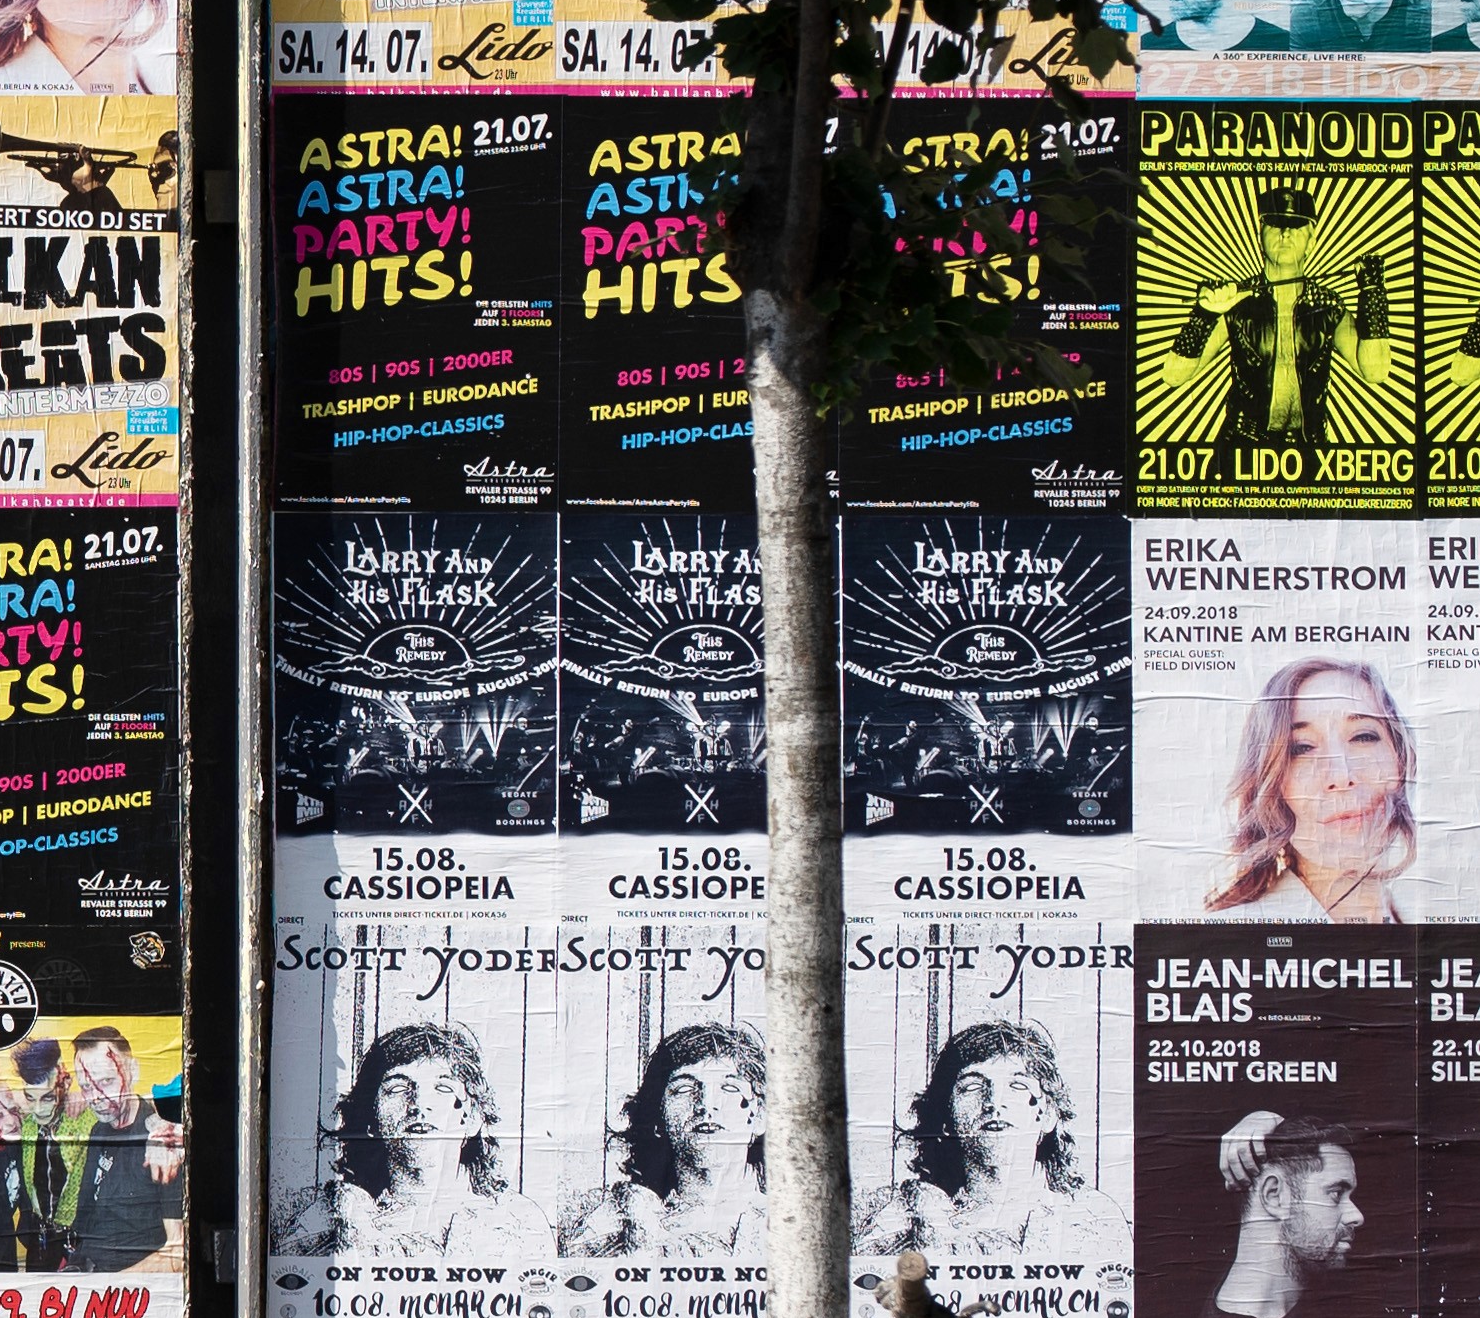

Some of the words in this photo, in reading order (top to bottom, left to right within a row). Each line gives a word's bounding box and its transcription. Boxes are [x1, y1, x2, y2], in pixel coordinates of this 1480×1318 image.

[1140, 111, 1413, 157] PARANOID
[1138, 449, 1223, 481] 21.07.
[1234, 449, 1303, 481] LIDO
[1316, 449, 1413, 481] XBERG
[84, 526, 163, 559] 21.07.
[1145, 539, 1242, 562] ERIKA
[1146, 566, 1406, 590] WENNERSTROM
[1145, 606, 1238, 619] 24.09.2018
[1144, 626, 1243, 643] KANTINE
[1251, 626, 1286, 643] AM
[1295, 626, 1409, 643] BERGHAIN
[1144, 650, 1185, 658] SPECIAL
[1189, 650, 1224, 658] GUEST:
[1145, 661, 1177, 671] FIELD
[1181, 661, 1235, 671] DIVISION
[56, 763, 127, 785] 2000ER
[37, 791, 152, 821] EURODANCE
[372, 847, 466, 872] 15.08.
[323, 874, 515, 901] CASSIOPEIA
[81, 900, 115, 908] REVALER
[117, 900, 152, 908] STRASSE
[95, 909, 124, 918] 10245
[127, 909, 153, 918] BERLIN
[1147, 958, 1412, 990] JEAN-MICHEL
[1146, 992, 1252, 1023] BLAIS
[1147, 1039, 1260, 1058] 22.10.2018
[1147, 1062, 1237, 1082] SILENT
[1246, 1061, 1338, 1082] GREEN
[325, 1266, 362, 1283] ON
[371, 1266, 437, 1283] TOUR
[446, 1266, 507, 1283] NOW
